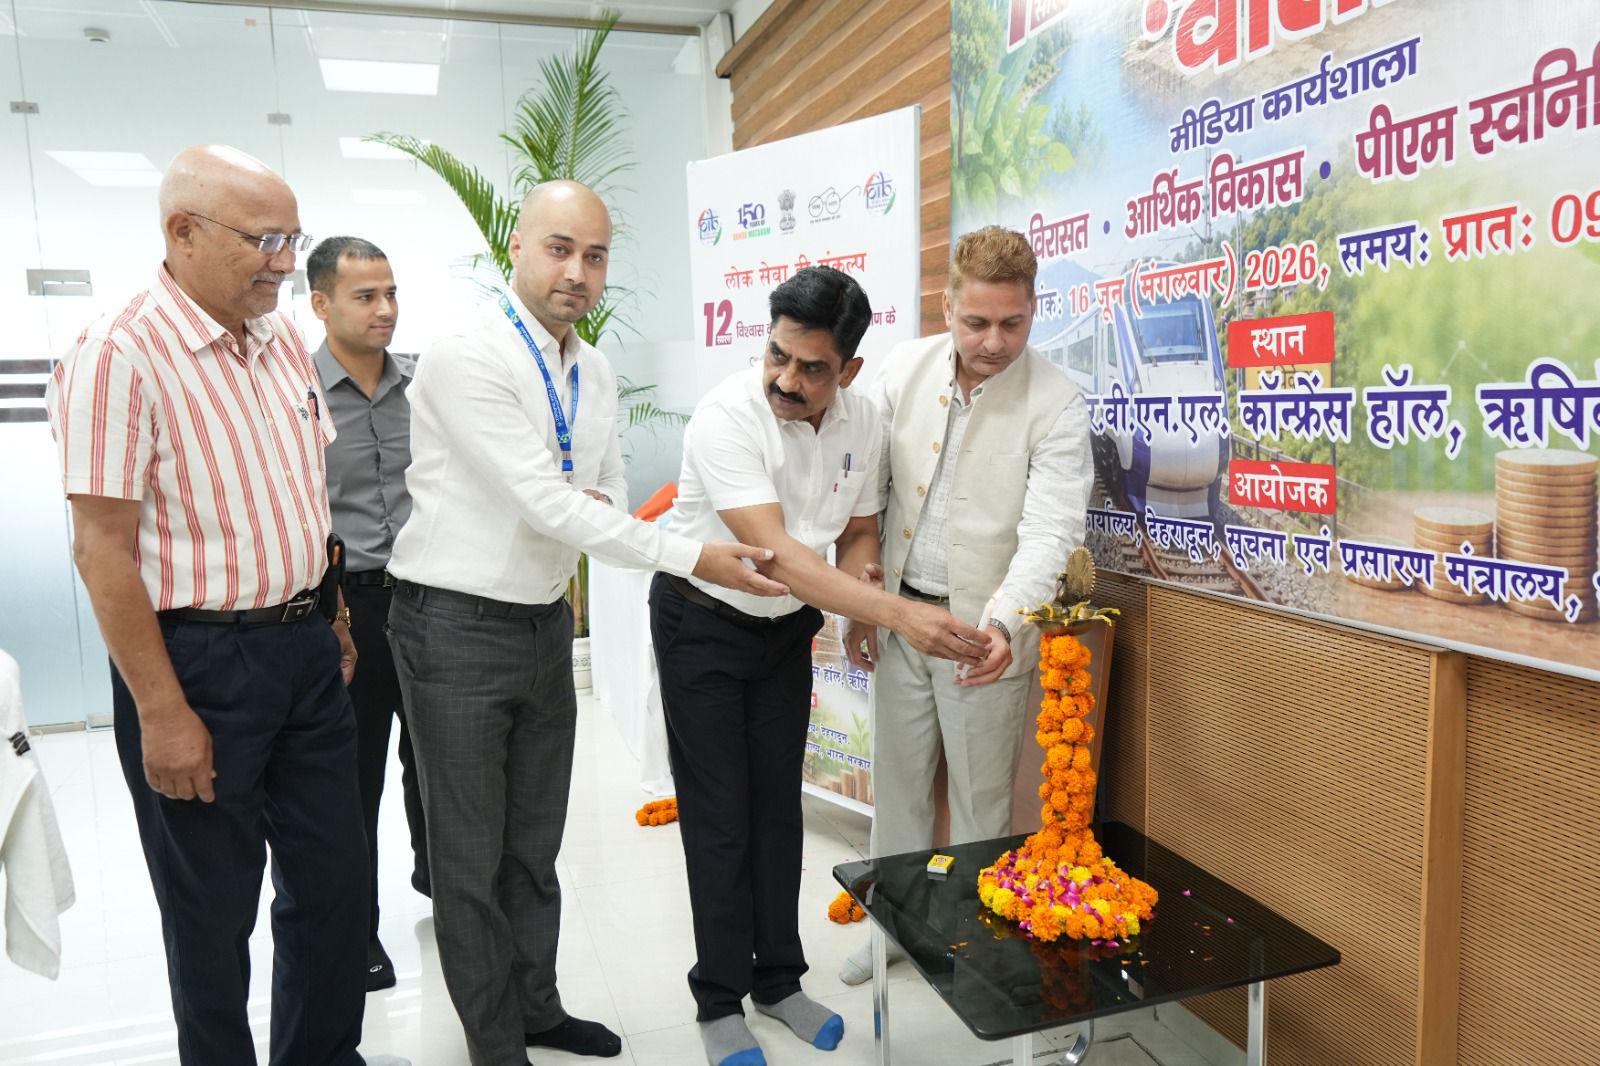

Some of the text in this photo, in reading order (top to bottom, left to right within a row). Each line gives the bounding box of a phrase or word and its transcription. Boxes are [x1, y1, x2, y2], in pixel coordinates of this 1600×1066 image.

[1170, 37, 1421, 152] मीडिया कार्यशाला
[1029, 40, 1600, 258] विरासत आर्थिक विकास पीएम स्वनि
[724, 266, 753, 289] लोक
[759, 262, 788, 286] सेवा
[1036, 284, 1062, 317] ांक:
[1069, 285, 1089, 315] 16
[1096, 280, 1126, 321] जून
[1132, 244, 1236, 316] (मंगलवार)
[1247, 244, 1328, 288] 2026,
[1339, 225, 1429, 273] समय:
[1443, 206, 1533, 258] प्रात:
[704, 299, 734, 346] 12
[736, 321, 765, 338] विश्वास
[885, 307, 897, 325] के
[1251, 325, 1306, 357] स्थान
[1087, 363, 1600, 453] र.वी.एन.एल. कॉन्फ्रेंस हॉल, ऋषि
[1234, 465, 1329, 506] आयोजक
[1146, 508, 1220, 559] देहरादून,
[1226, 526, 1287, 568] सूचना
[1295, 527, 1330, 574] एवं
[1340, 542, 1434, 586] प्रसारण
[1447, 544, 1582, 617] मंत्रालय,
